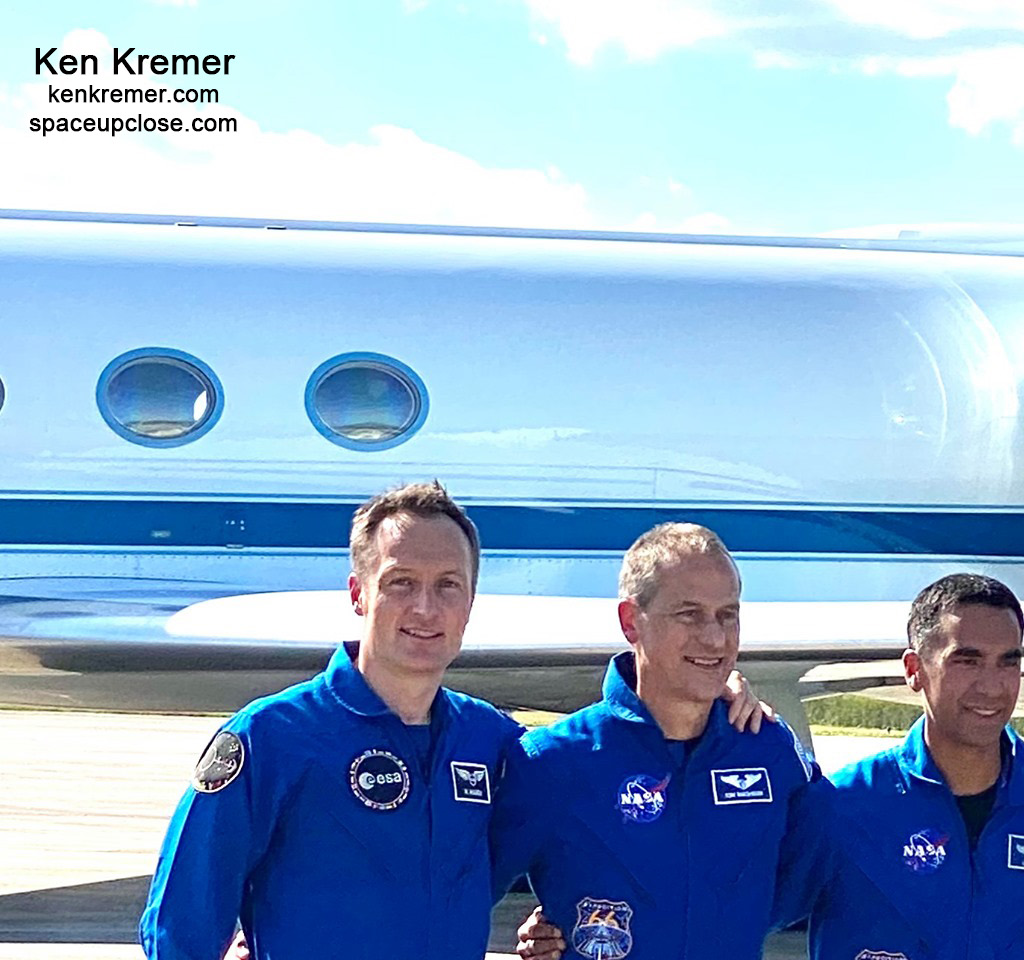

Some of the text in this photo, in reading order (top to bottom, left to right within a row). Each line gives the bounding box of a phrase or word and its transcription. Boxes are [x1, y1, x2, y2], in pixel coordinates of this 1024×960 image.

[376, 770, 403, 785] esa
[620, 791, 665, 807] NASA
[902, 843, 947, 859] NASA
